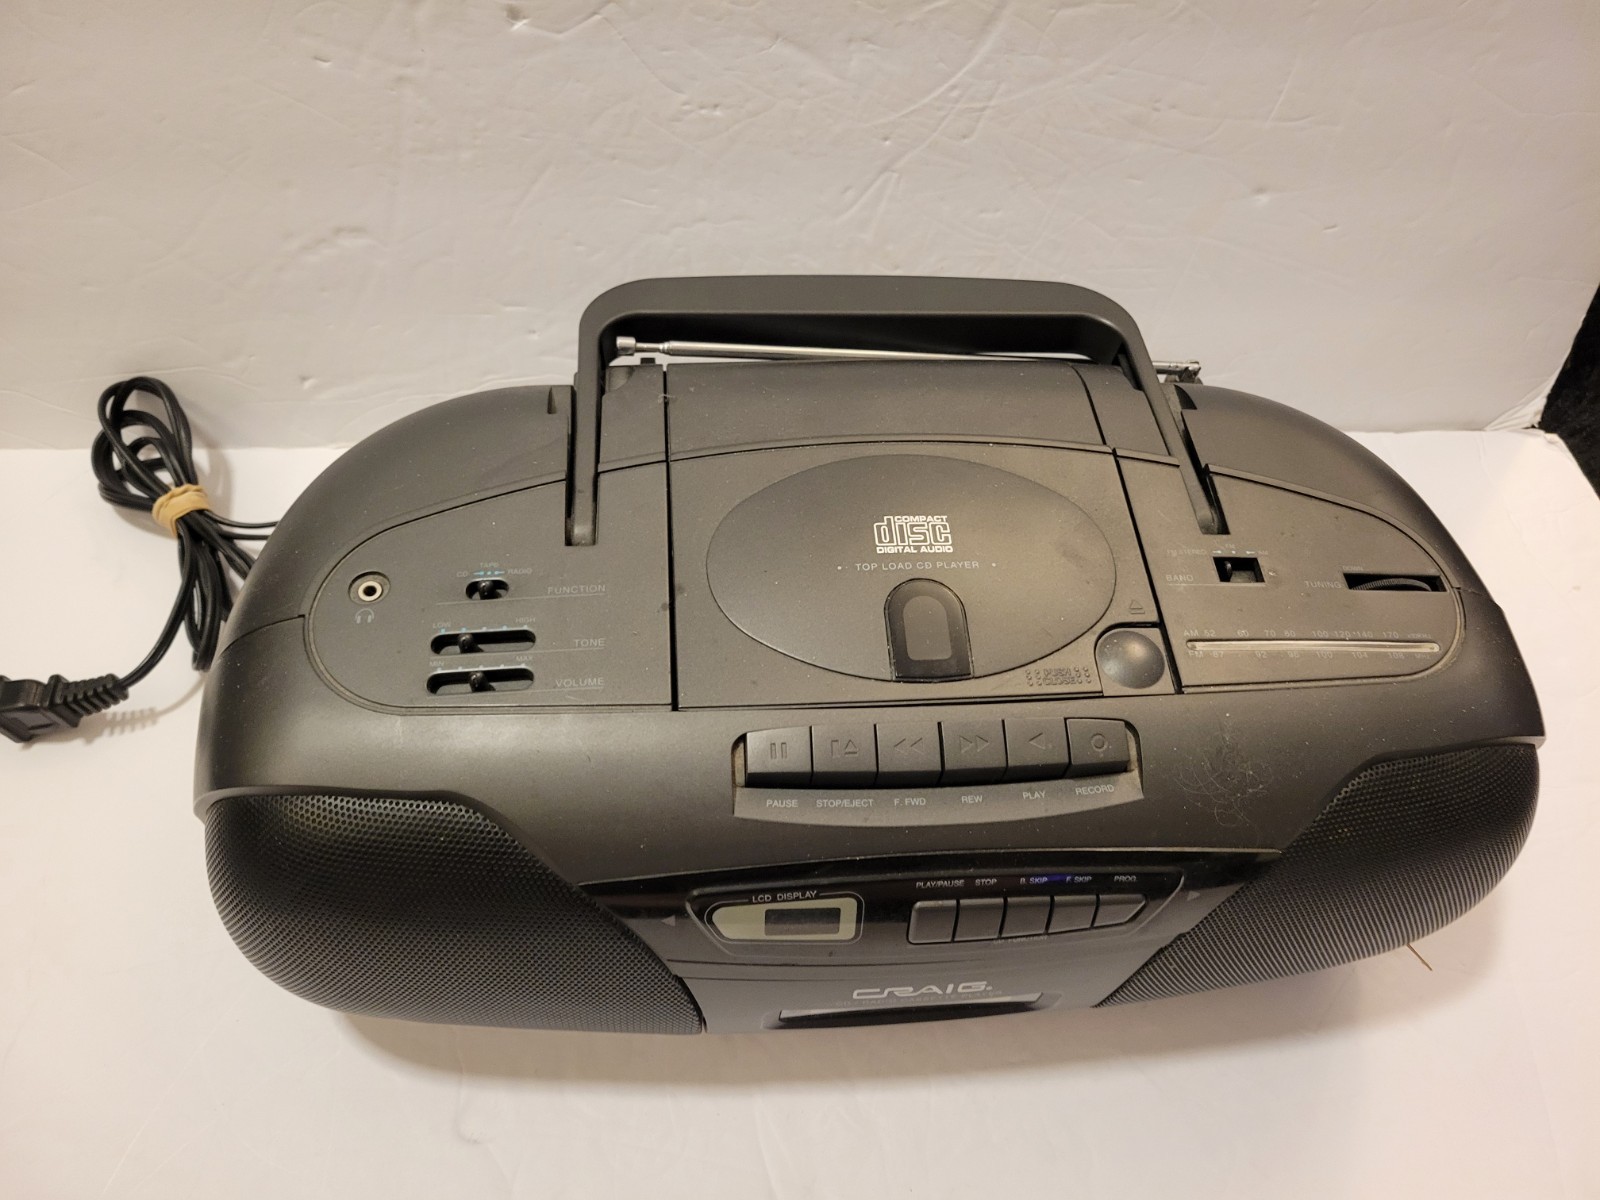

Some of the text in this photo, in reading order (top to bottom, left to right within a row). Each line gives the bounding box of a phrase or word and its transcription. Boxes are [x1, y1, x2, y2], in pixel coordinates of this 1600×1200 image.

[895, 515, 948, 523] COMPACT
[876, 545, 954, 554] DIGITAL AUDIO
[508, 567, 533, 575] RADIO
[855, 561, 980, 572] TOP LOAD CD PLAYER
[1166, 574, 1194, 582] BAND
[547, 584, 607, 595] FUNCTION
[1305, 580, 1342, 589] TUNING
[1184, 629, 1199, 637] AM
[1264, 629, 1276, 637] 70
[1312, 630, 1329, 638] 100
[1334, 631, 1351, 639] 120
[1356, 631, 1374, 639] 140
[1382, 631, 1399, 639] 170
[573, 638, 606, 647] TONE
[1316, 651, 1334, 659] 100
[555, 677, 605, 687] VOLUME
[1075, 784, 1115, 795] RECORD
[961, 795, 984, 804] REW
[1022, 790, 1046, 800] PLAY
[766, 799, 799, 809] PAUSE
[816, 798, 874, 808] STOP/EJECT
[893, 797, 927, 807] F. FWD
[916, 879, 965, 889] PLAY/PAUSE
[975, 878, 997, 887] STOP
[1029, 877, 1048, 885] SKIP
[1074, 876, 1093, 884] SKIP
[752, 890, 817, 904] LCD DISPLAY
[852, 981, 988, 1000] CRAIG
